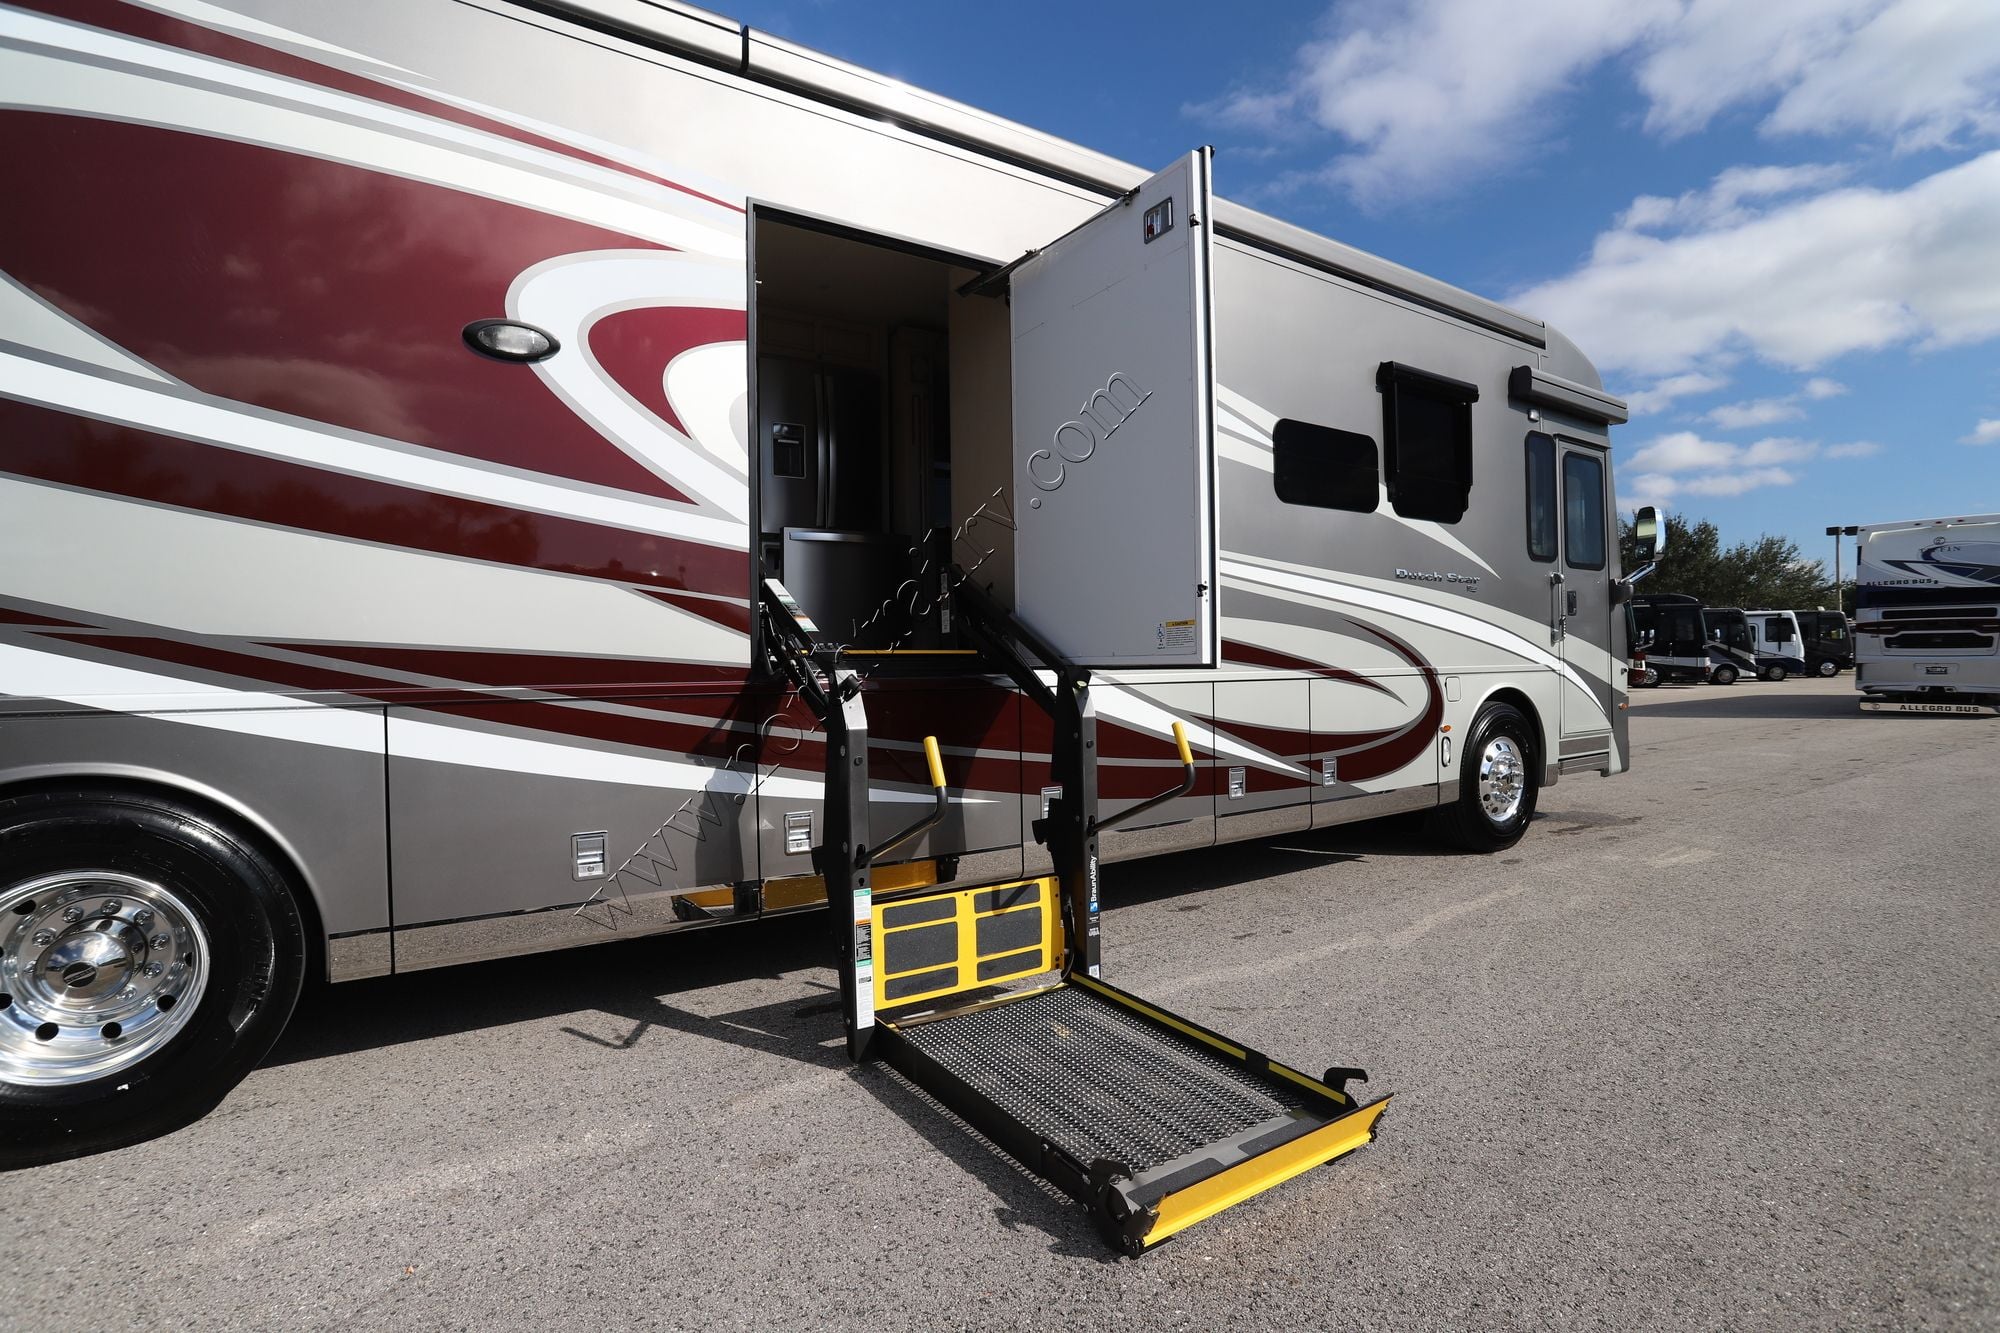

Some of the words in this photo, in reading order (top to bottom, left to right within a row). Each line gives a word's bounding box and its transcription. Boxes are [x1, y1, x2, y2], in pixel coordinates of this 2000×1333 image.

[1395, 568, 1443, 582] Dutch
[1447, 572, 1481, 585] Star
[1866, 579, 1910, 587] ALLEGRO
[1899, 704, 1952, 712] ALLEGRO
[1089, 855, 1099, 903] BraunAbility
